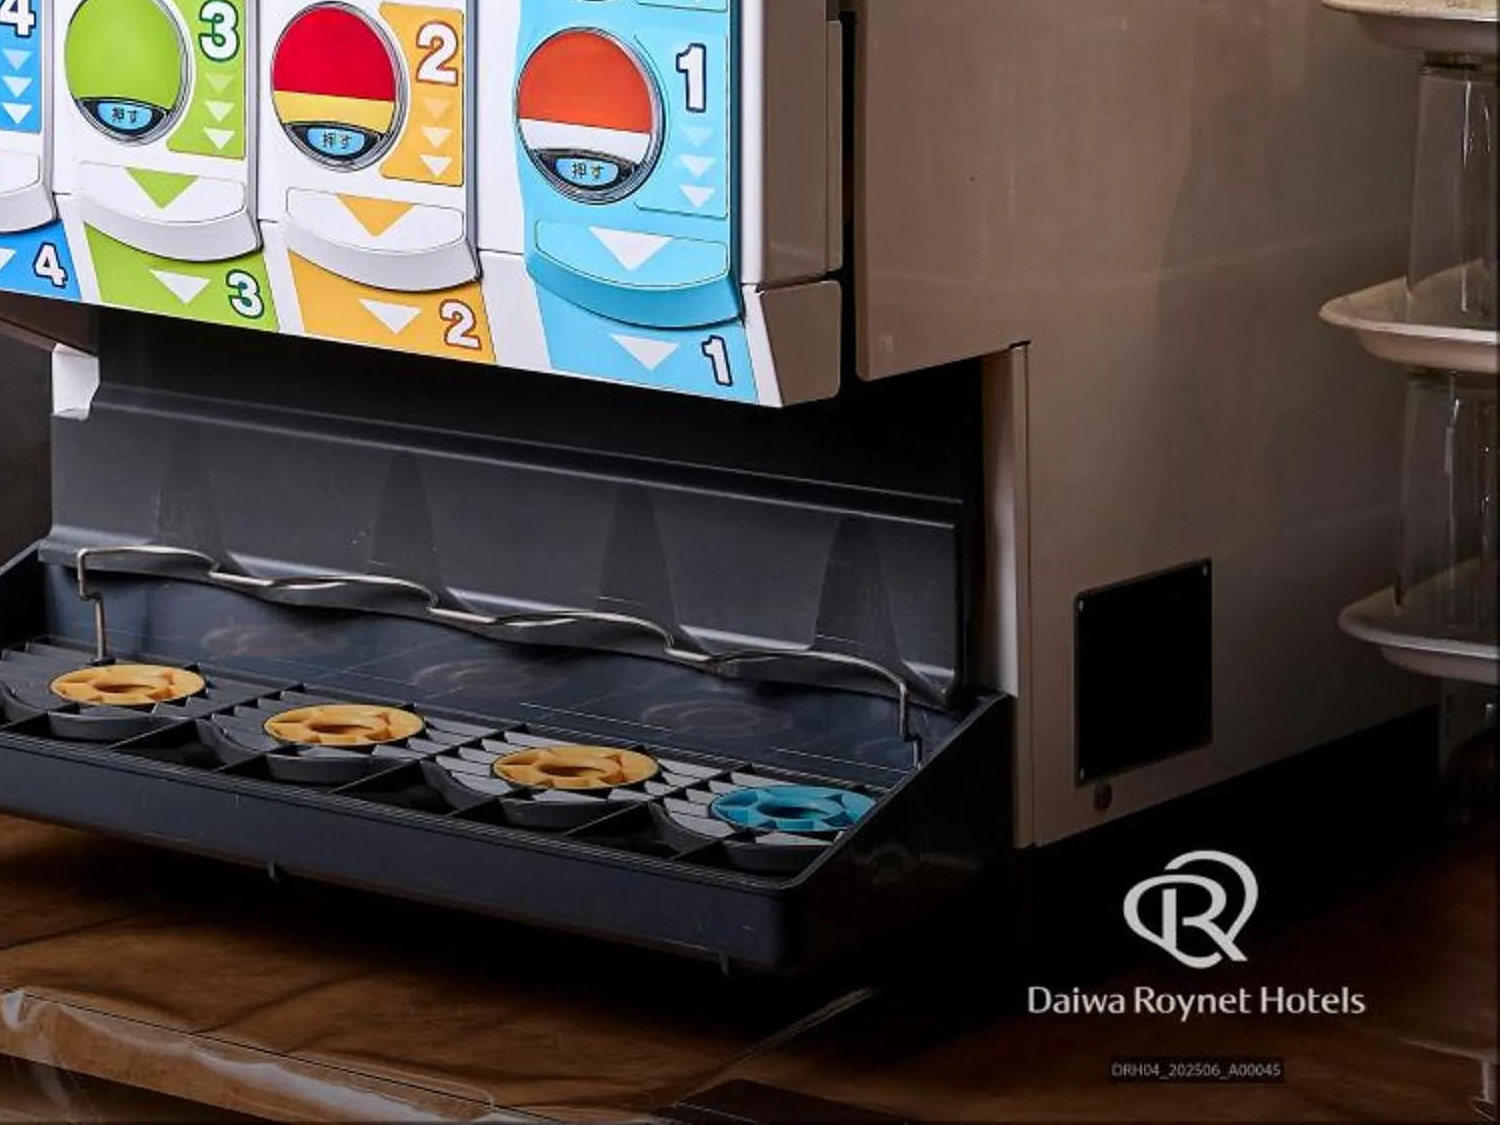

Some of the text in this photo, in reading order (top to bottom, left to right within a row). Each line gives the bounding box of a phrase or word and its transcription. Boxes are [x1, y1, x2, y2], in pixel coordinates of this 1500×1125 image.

[416, 20, 459, 87] 2
[676, 42, 707, 113] 1
[111, 105, 139, 124] 押す
[321, 129, 354, 151] 押す
[570, 161, 605, 181] 押す
[33, 242, 68, 288] 4
[225, 269, 265, 319] 3
[439, 298, 482, 351] 2
[701, 334, 733, 387] 1
